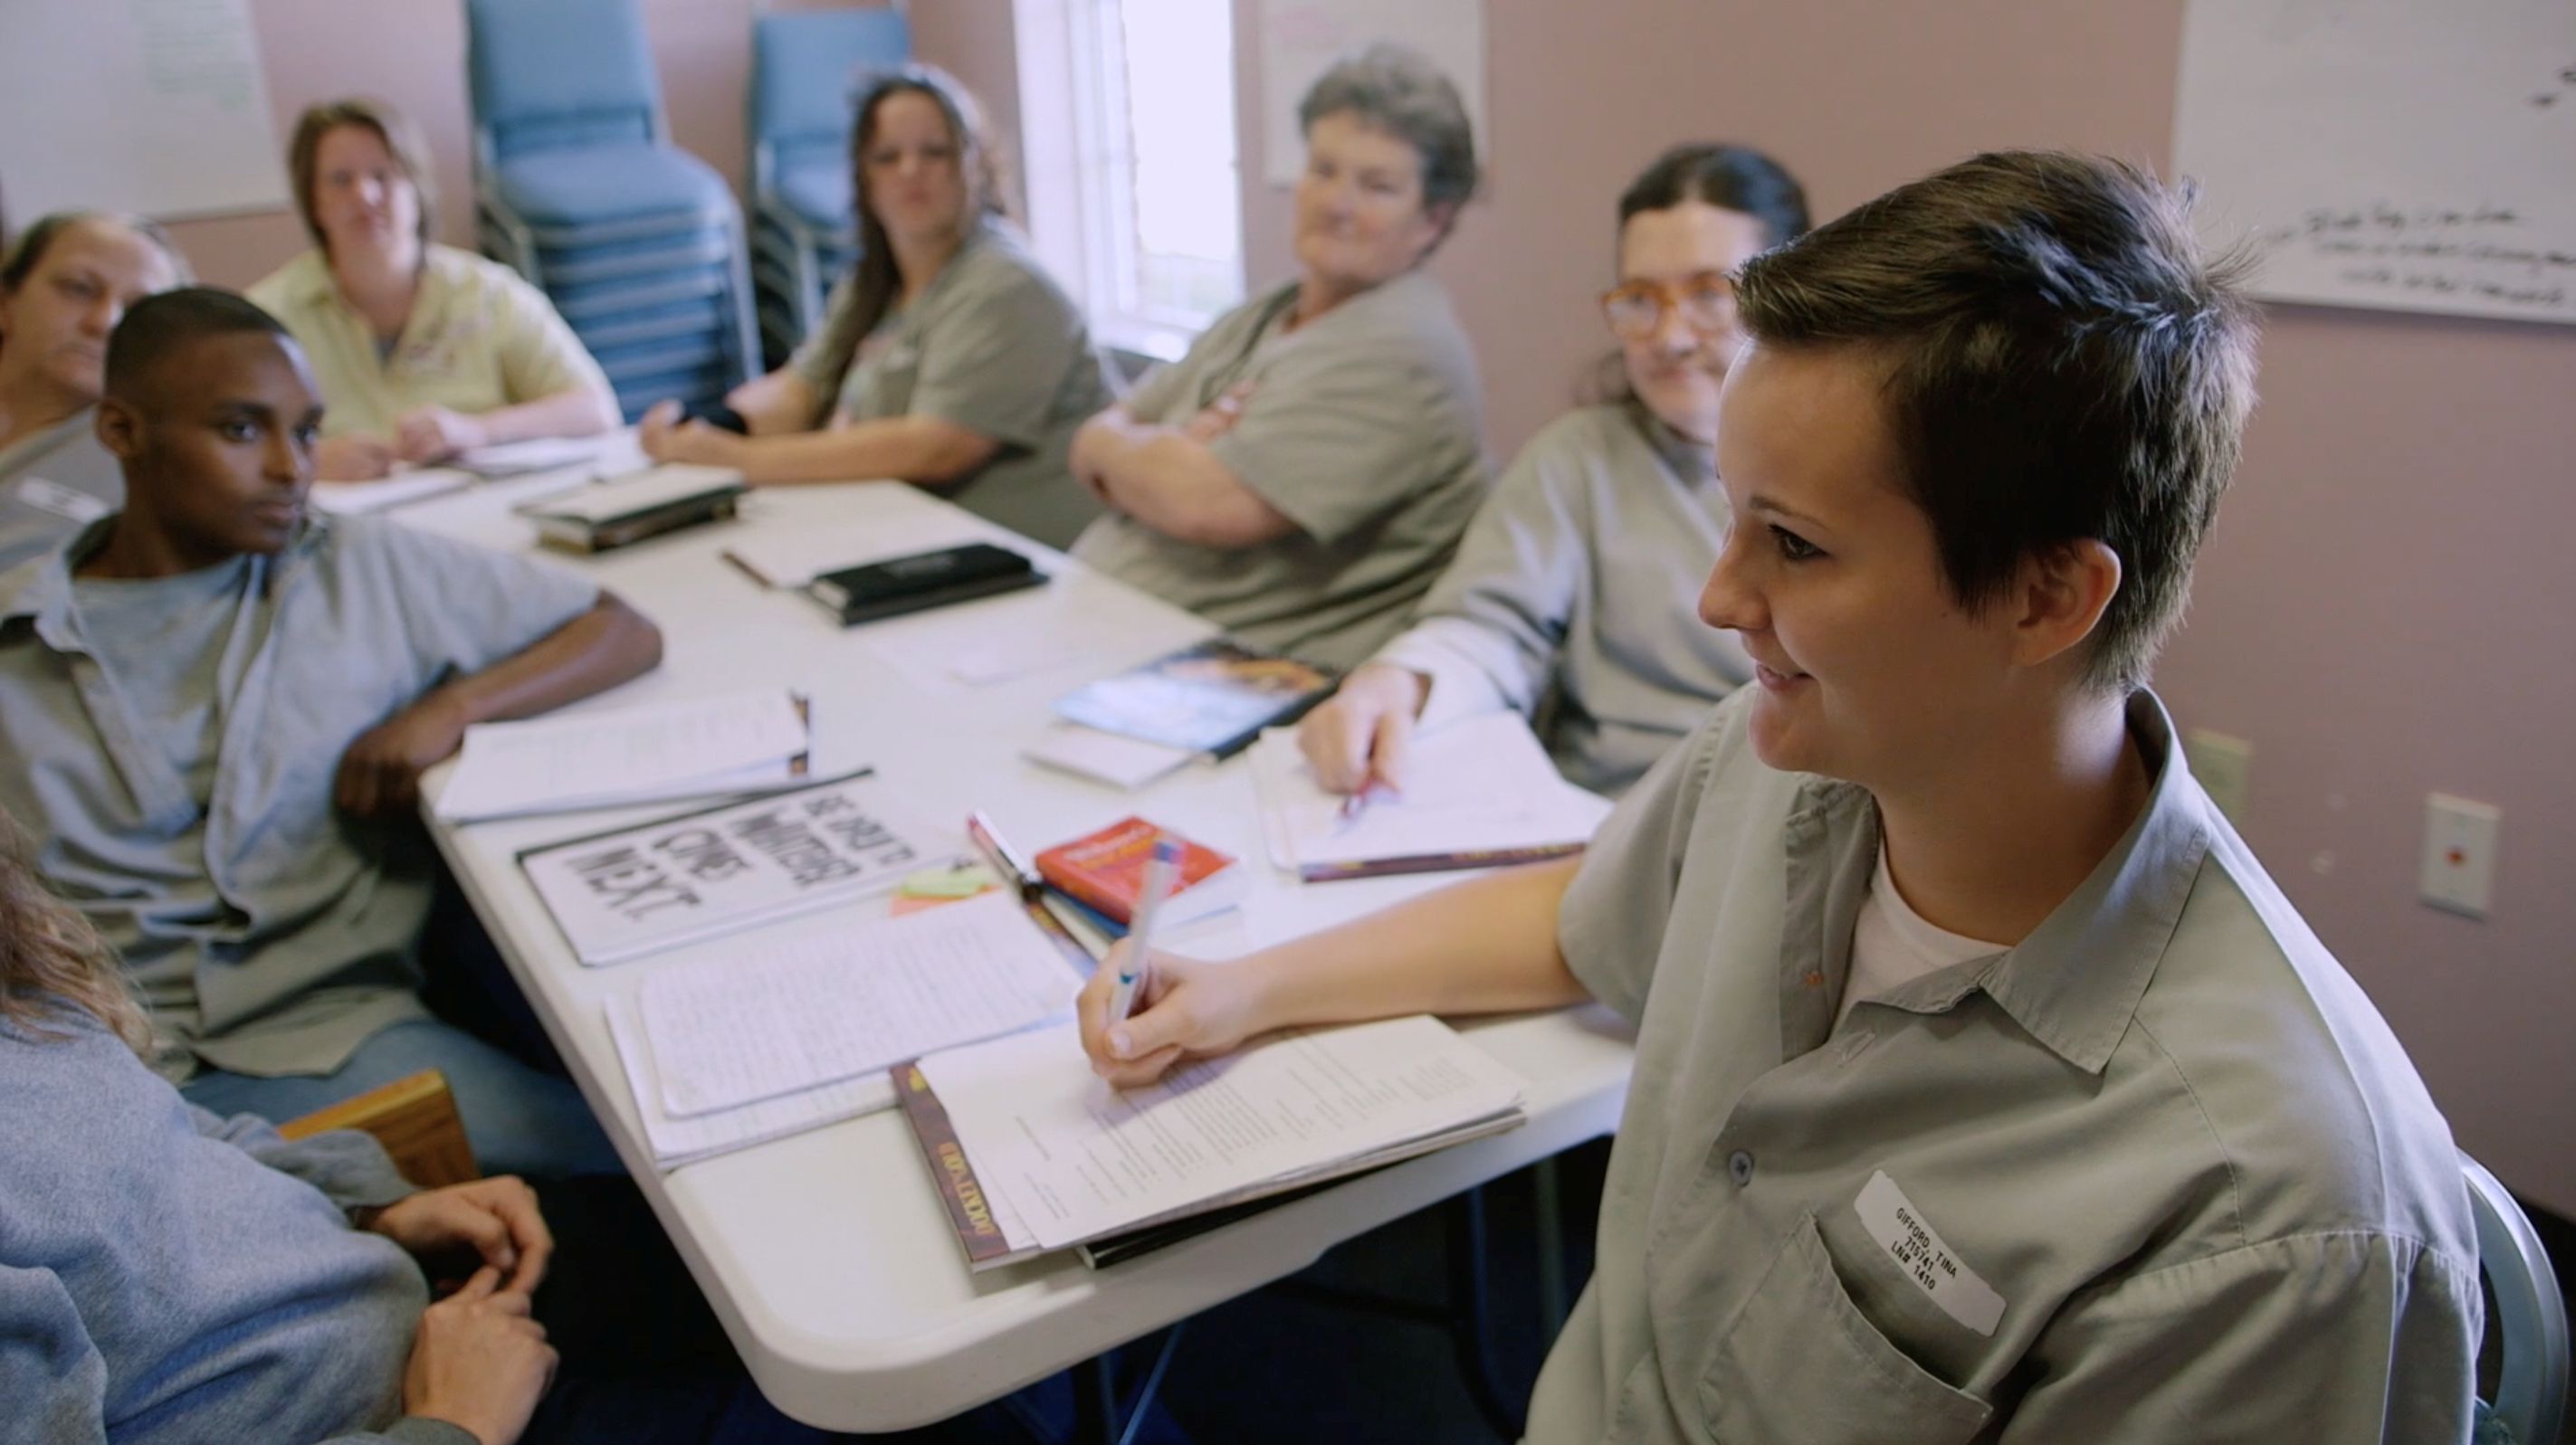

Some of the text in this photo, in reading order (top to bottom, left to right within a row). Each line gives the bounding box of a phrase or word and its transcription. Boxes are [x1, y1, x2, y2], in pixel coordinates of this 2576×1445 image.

[1891, 1241, 1936, 1290] LN# 1410
[1896, 1207, 1957, 1279] GIFFORD, TINA
[1904, 1236, 1934, 1272] 715741
